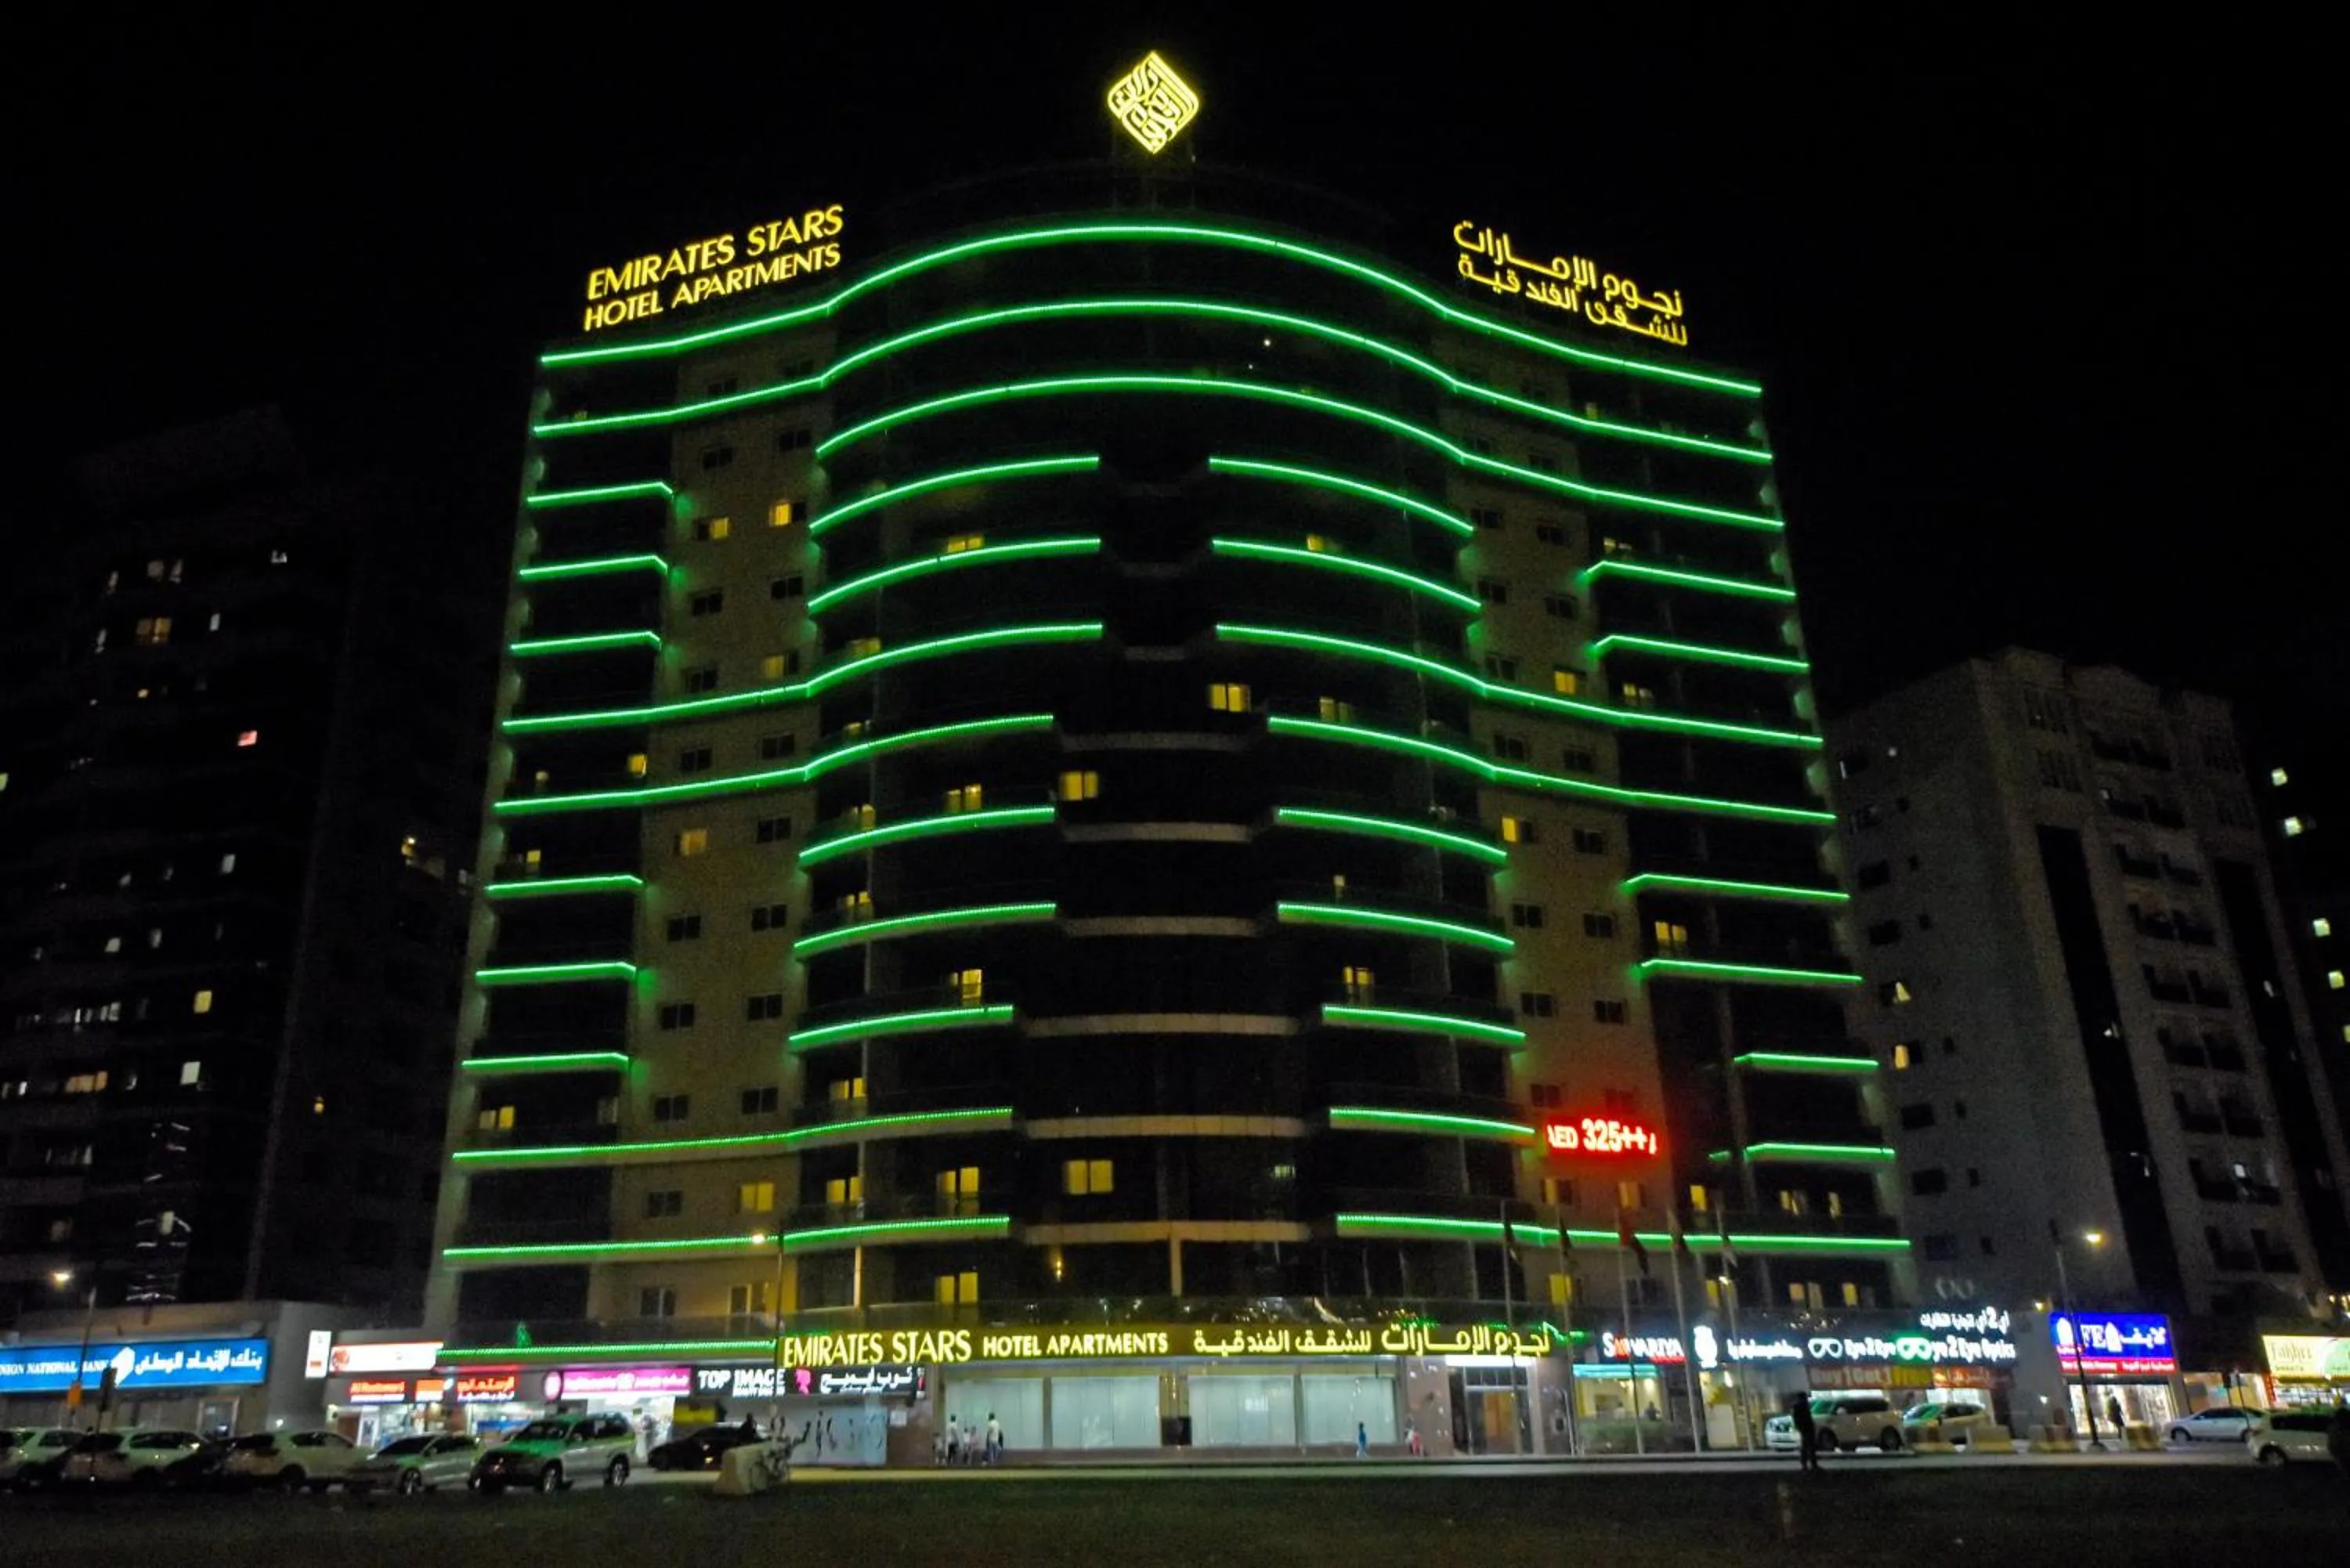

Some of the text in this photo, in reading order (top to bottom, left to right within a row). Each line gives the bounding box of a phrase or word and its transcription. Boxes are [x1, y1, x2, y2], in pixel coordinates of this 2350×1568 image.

[587, 204, 844, 301] EMIRATES STARS
[584, 243, 841, 331] HOTEL APARTMENTS
[1603, 274, 1683, 318] نجوم
[1585, 300, 1688, 346] للشقق
[783, 1330, 1168, 1368] EMIRATES STARS HOTEL APARTMENTS
[1295, 1329, 1372, 1353] للشقق
[698, 1370, 731, 1390] TOP
[733, 1368, 786, 1386] IMAGE
